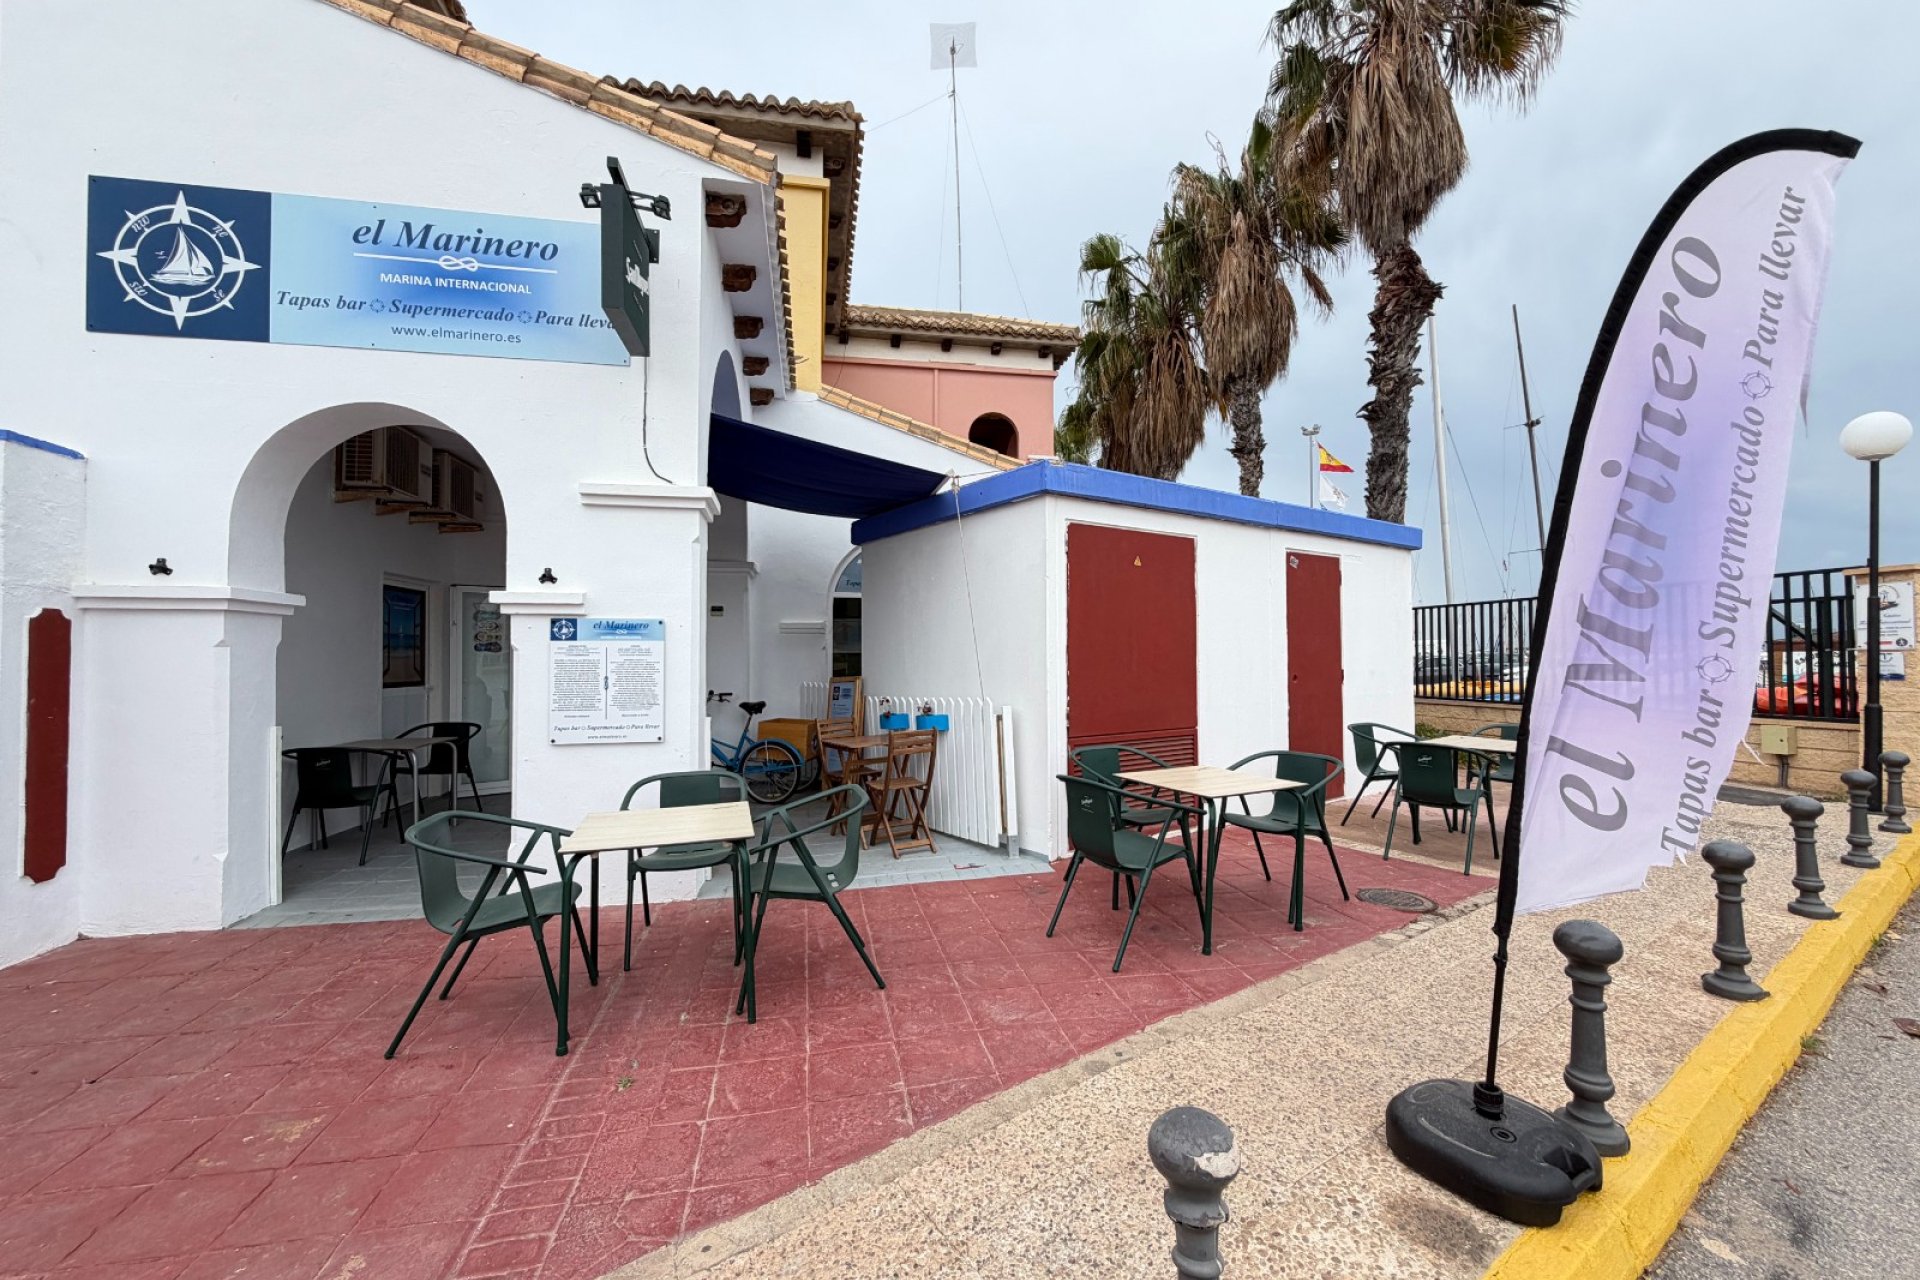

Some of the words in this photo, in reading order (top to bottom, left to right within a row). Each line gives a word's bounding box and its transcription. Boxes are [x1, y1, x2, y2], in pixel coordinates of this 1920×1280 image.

[352, 219, 386, 246] el
[392, 220, 559, 261] Marinero
[1758, 186, 1806, 281] llevar
[277, 290, 331, 311] Tapas
[336, 295, 367, 311] bar
[388, 298, 515, 323] Supermercado
[534, 310, 573, 327] Para
[578, 313, 616, 330] lleva
[380, 273, 432, 287] MARINA
[435, 278, 532, 294] INTERNACIONAL
[391, 326, 522, 344] www.elmarinero.es
[1741, 289, 1785, 370] Para
[1561, 236, 1722, 724] Marinero
[1698, 406, 1766, 650] Supermercado
[1681, 688, 1724, 748] bar
[1546, 735, 1636, 832] el
[1661, 756, 1712, 852] Tapas
